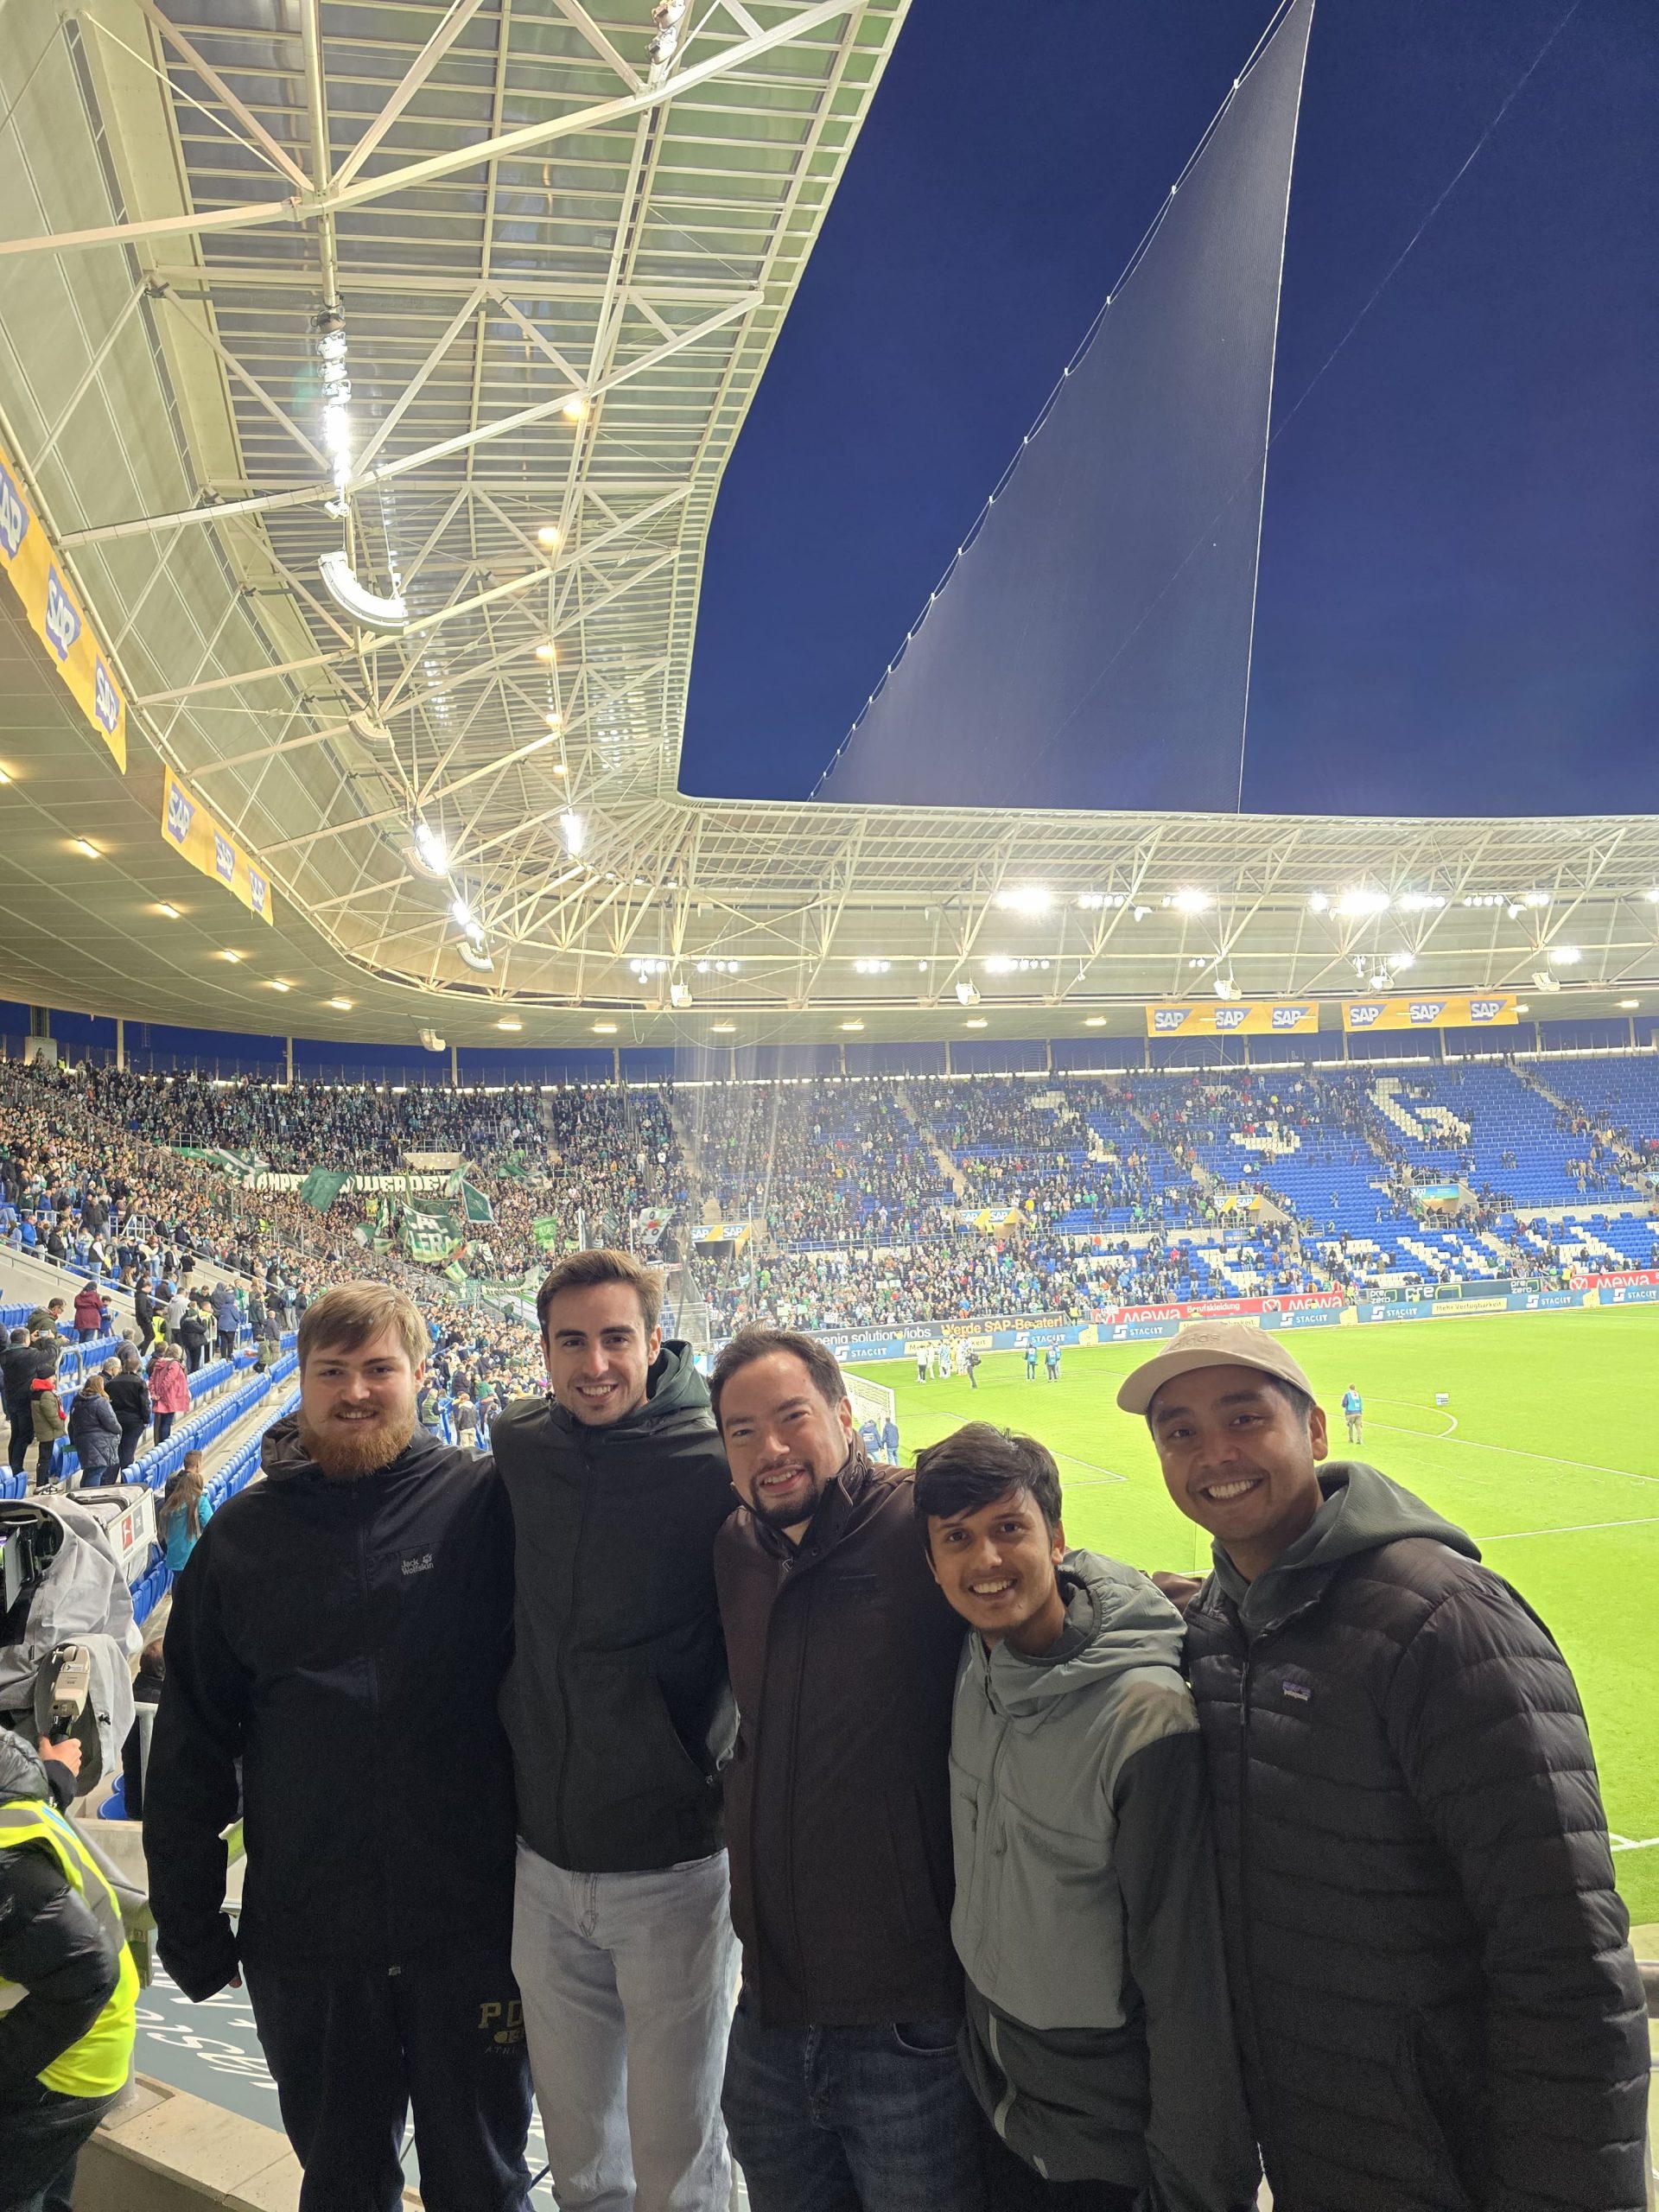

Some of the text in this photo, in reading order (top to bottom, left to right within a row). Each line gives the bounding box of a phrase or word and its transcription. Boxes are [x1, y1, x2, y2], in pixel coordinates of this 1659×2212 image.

[47, 578, 75, 654] SAP
[96, 666, 118, 731] SAP
[168, 789, 264, 907] SAP SAP SAP
[1154, 1010, 1301, 1028] SAP SAP SAP
[1350, 1003, 1500, 1023] SAP SAP SAP
[1236, 1198, 1253, 1207] SAP
[989, 1211, 1008, 1221] SAP
[691, 1227, 743, 1237] SAP SAP
[401, 1558, 419, 1569] Jack
[401, 1562, 434, 1576] Wolfskin
